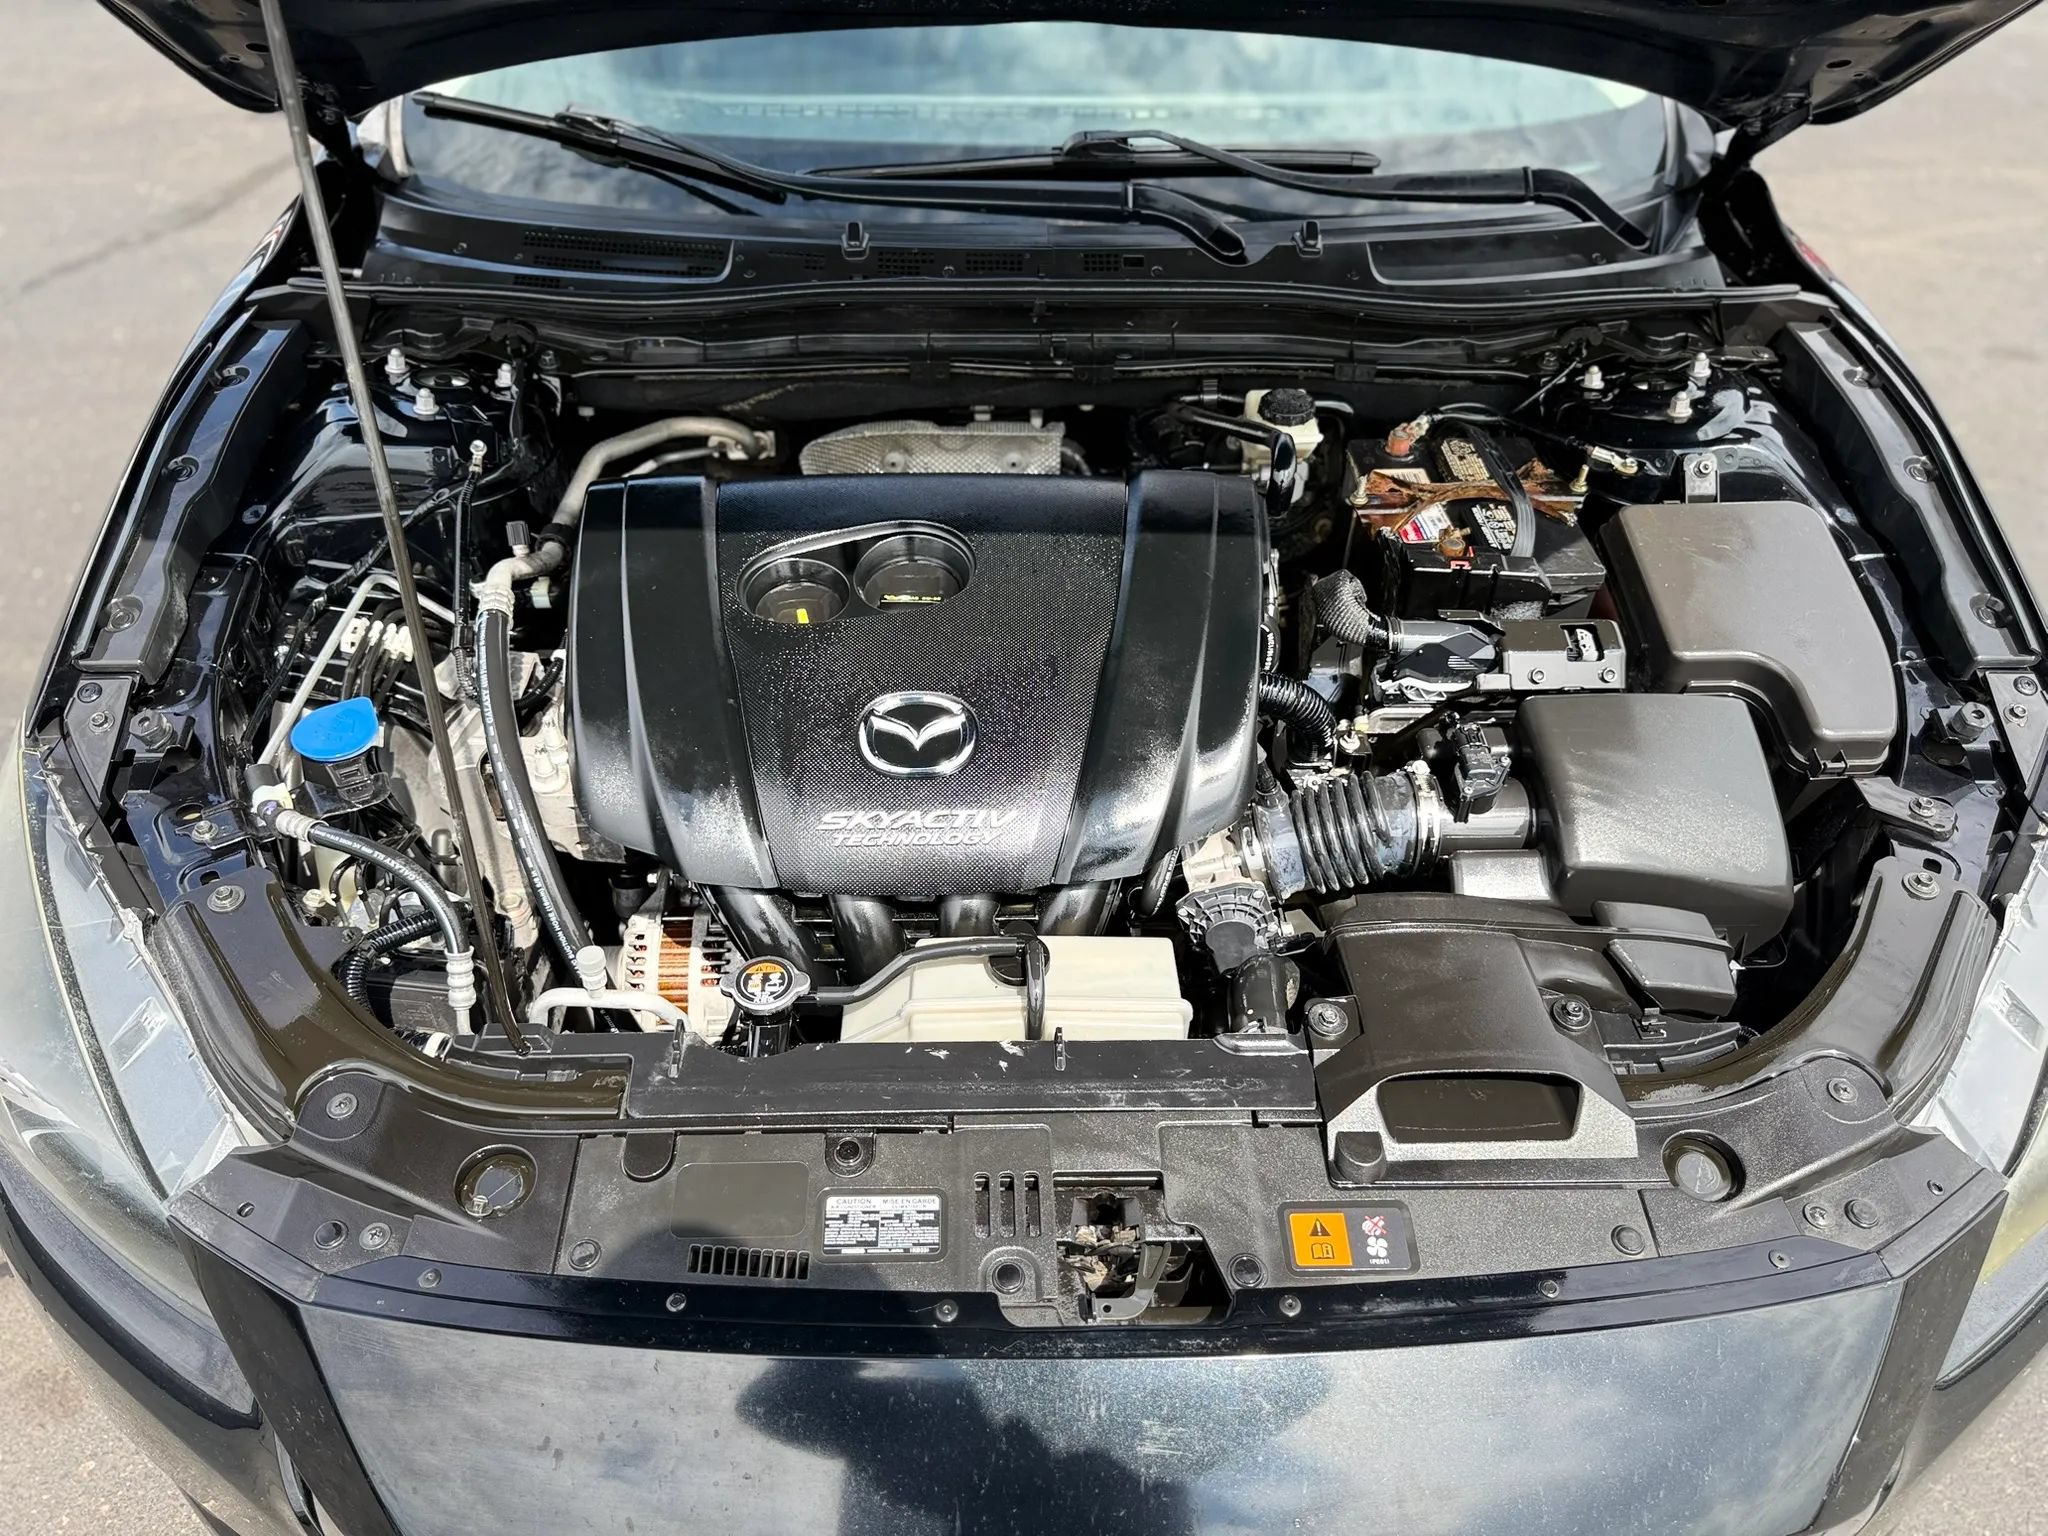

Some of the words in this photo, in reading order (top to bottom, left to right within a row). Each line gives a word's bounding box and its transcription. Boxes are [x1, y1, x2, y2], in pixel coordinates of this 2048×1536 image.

[481, 689, 494, 723] GALAXY
[815, 810, 1022, 831] SKYACTIV
[832, 832, 1002, 848] TECHNOLOGY
[383, 857, 416, 880] GALAXY
[548, 911, 561, 931] HOSE
[557, 930, 575, 959] SUCTION
